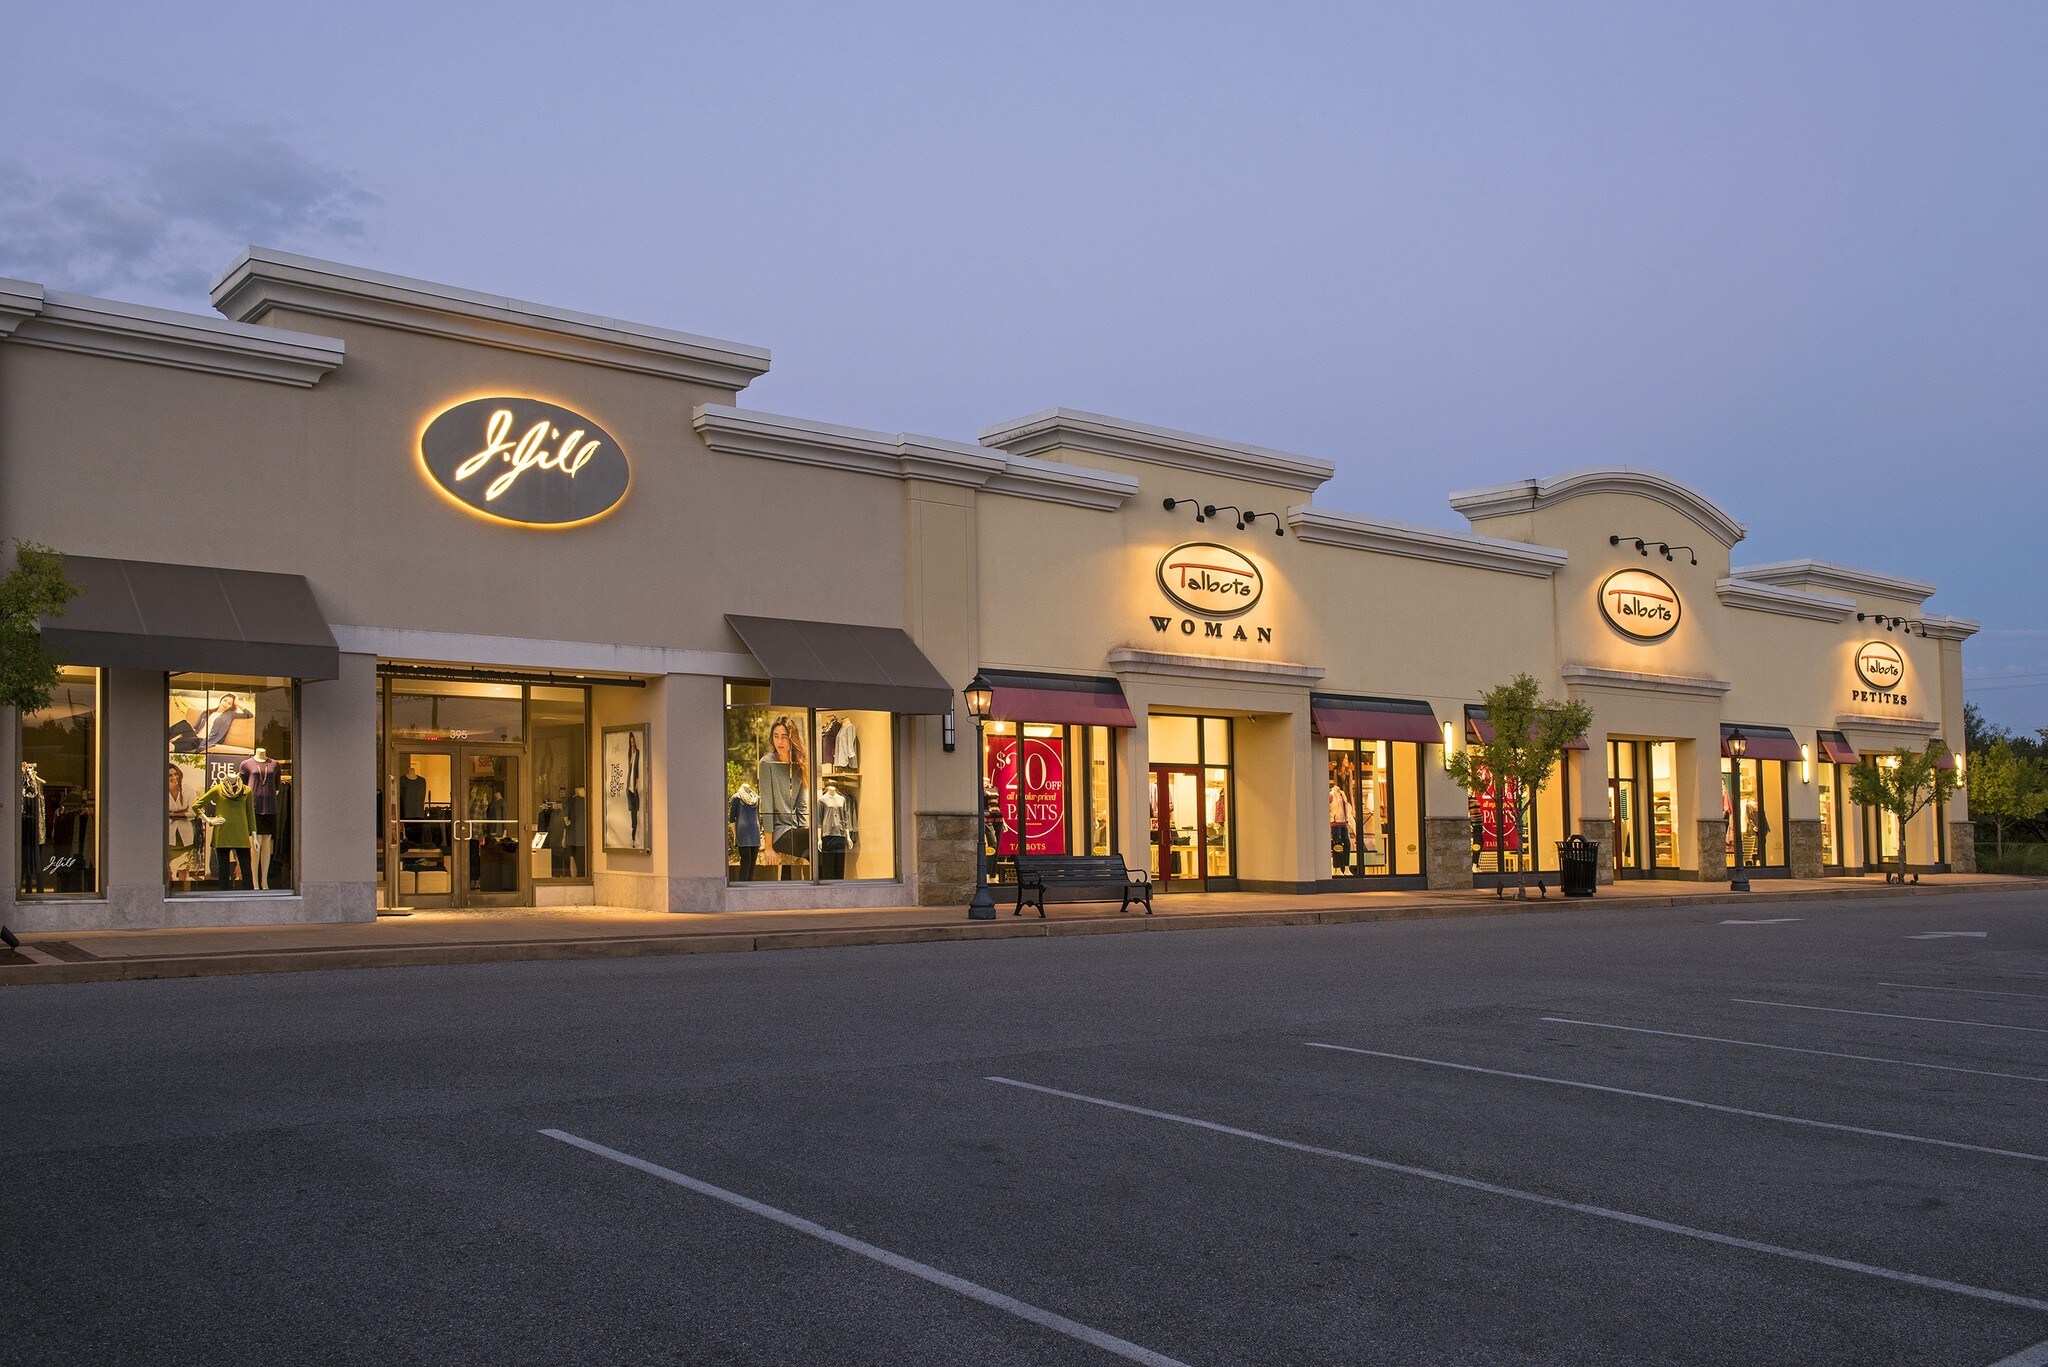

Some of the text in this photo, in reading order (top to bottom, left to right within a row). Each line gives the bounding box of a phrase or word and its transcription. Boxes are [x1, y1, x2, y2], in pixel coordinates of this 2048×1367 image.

[455, 409, 601, 501] J.Jill
[1169, 562, 1255, 597] Talbots
[1608, 589, 1674, 621] Talbots
[1149, 615, 1272, 643] WOMAN
[1861, 655, 1900, 676] Talbots
[1852, 690, 1908, 705] PETITES
[449, 729, 468, 739] 395
[210, 762, 235, 774] THE
[996, 750, 1062, 791] $20 OFF
[1483, 809, 1516, 823] PATS
